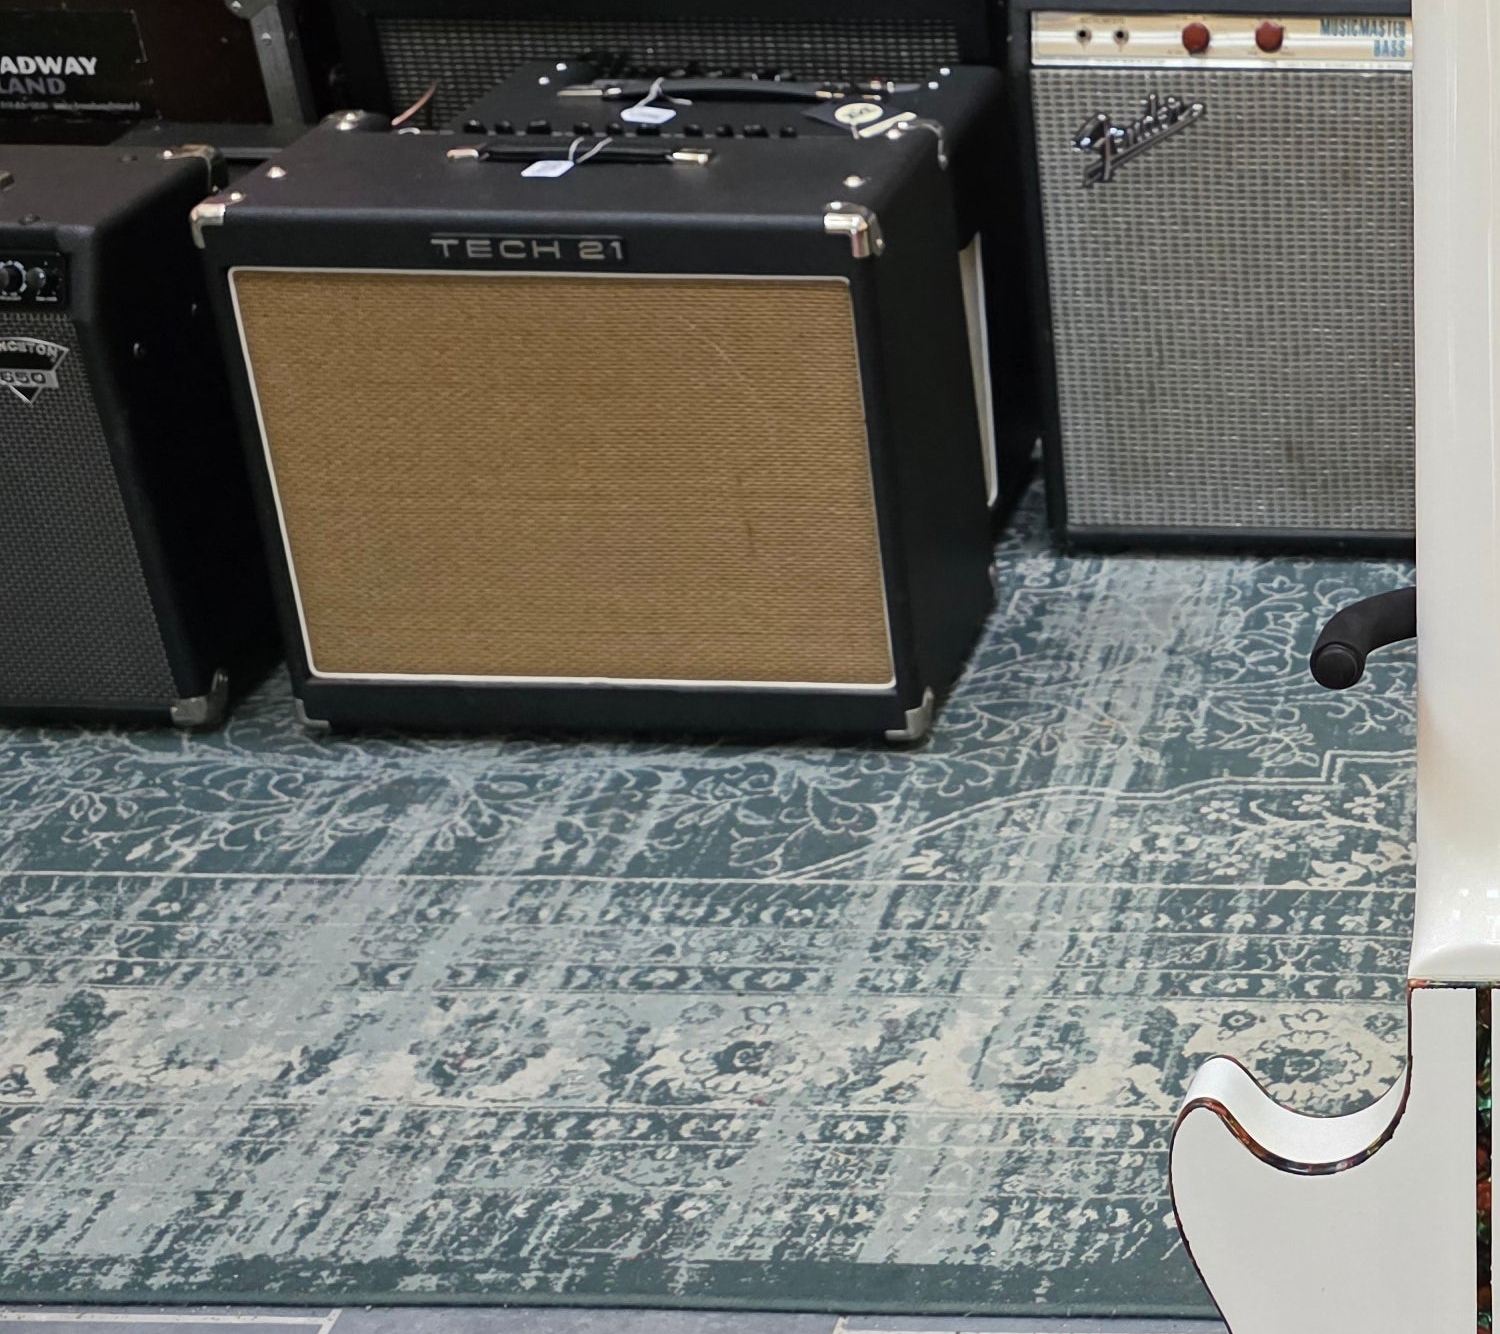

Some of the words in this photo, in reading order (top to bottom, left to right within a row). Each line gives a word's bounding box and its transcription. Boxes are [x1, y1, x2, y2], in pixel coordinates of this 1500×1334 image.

[1320, 19, 1406, 37] MUSICMASTER
[1374, 40, 1406, 57] BASS
[1070, 92, 1206, 187] Fender
[430, 238, 561, 259] TECH
[578, 241, 624, 260] 21
